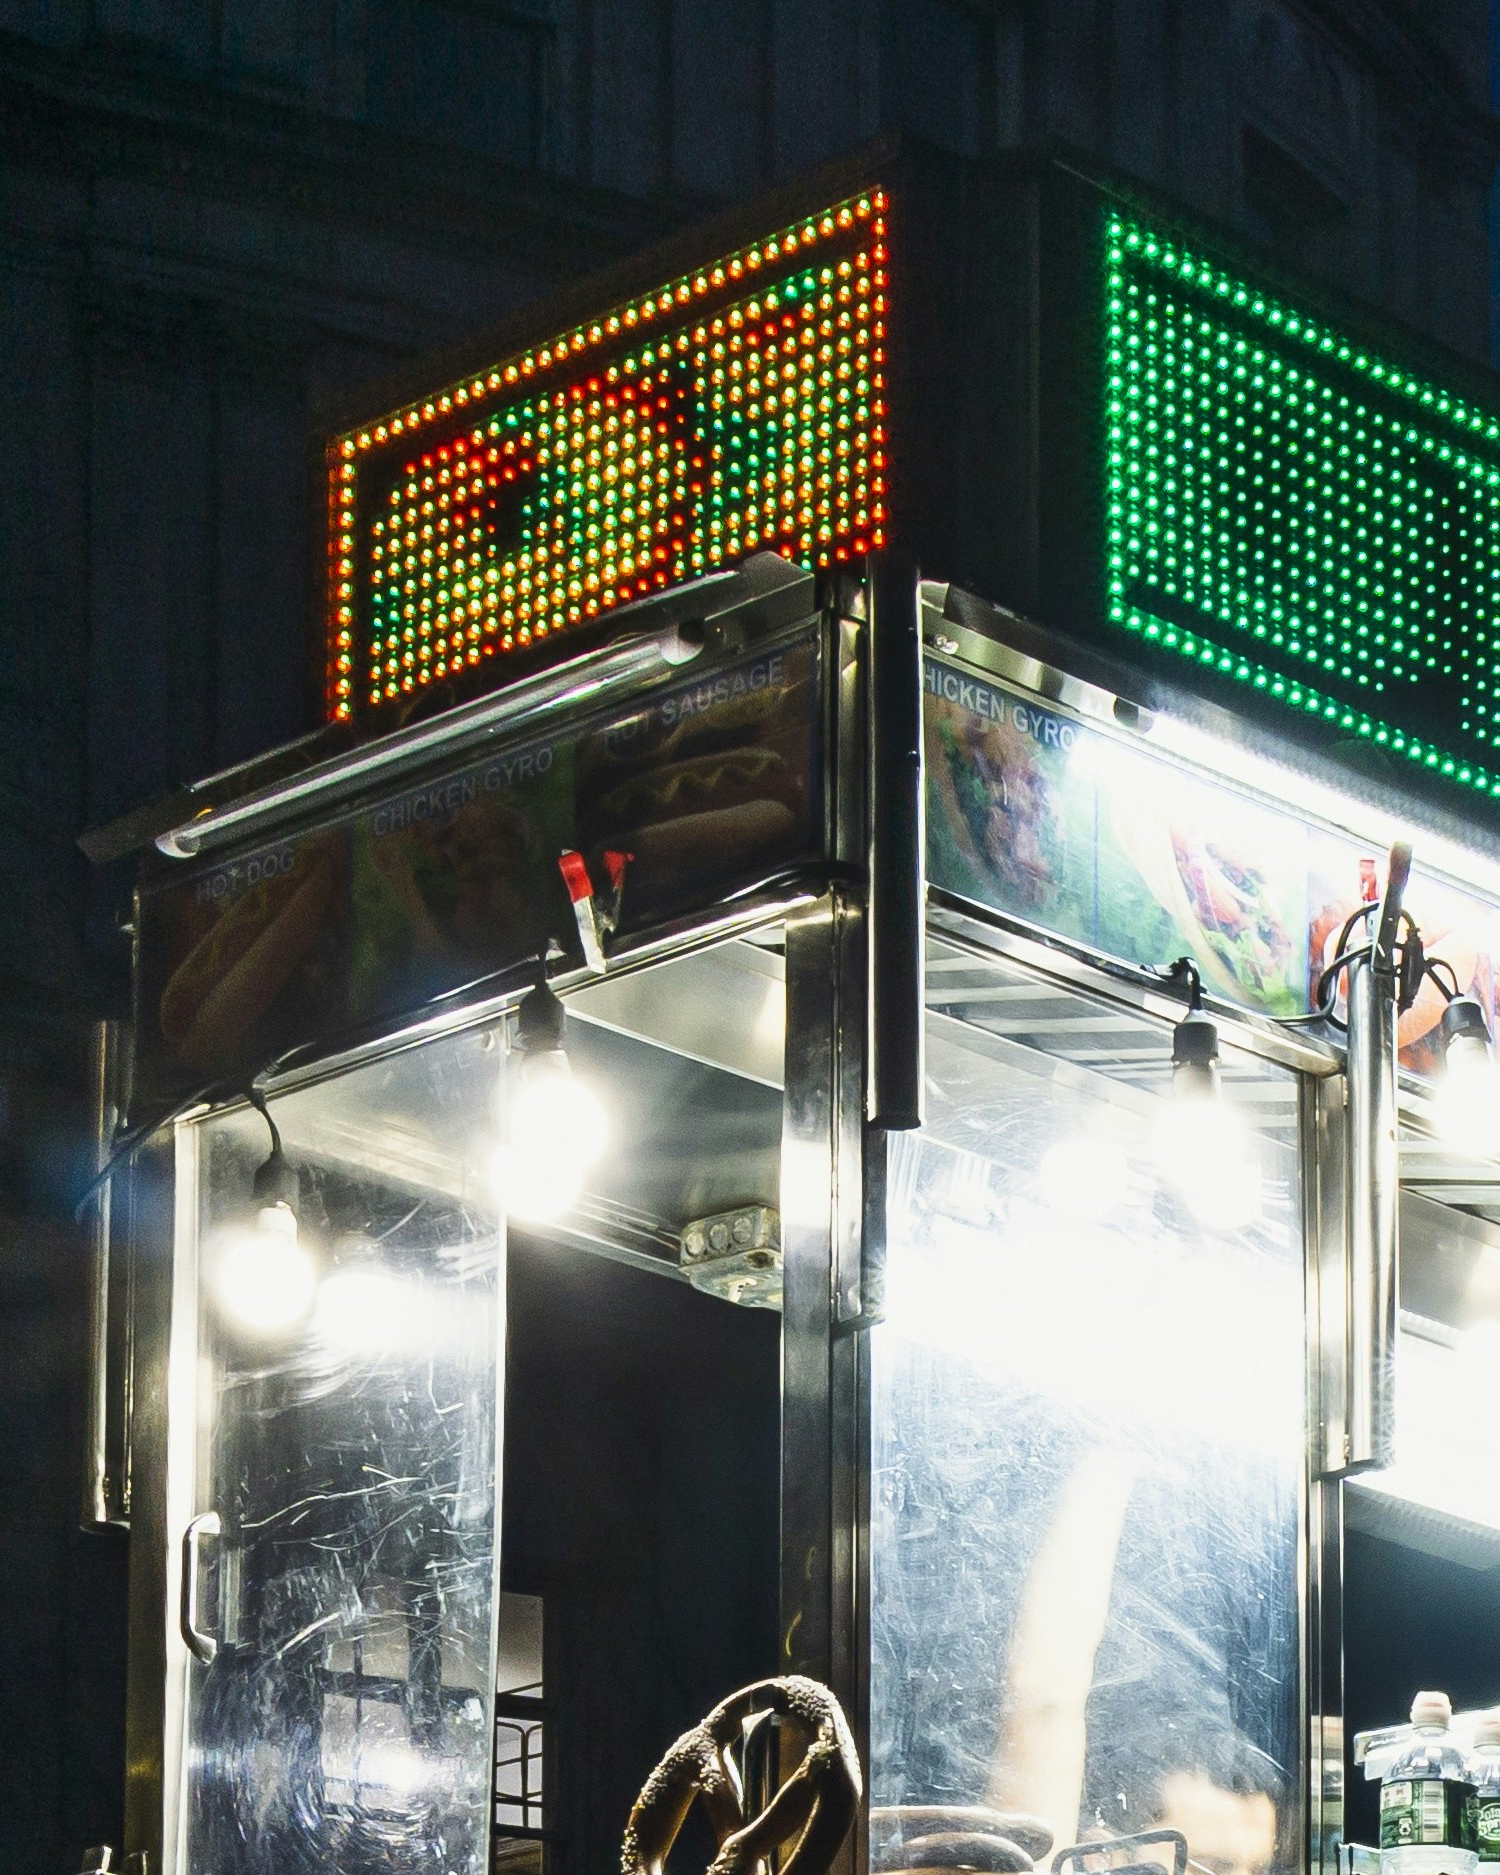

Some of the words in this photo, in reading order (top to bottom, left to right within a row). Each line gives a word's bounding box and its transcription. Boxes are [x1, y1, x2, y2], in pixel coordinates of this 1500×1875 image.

[660, 655, 785, 725] SAUSAGE
[924, 666, 1006, 723] HICKEN
[1012, 704, 1077, 753] GYRO
[372, 774, 477, 837] CHICKEN
[482, 746, 554, 793] GYRO
